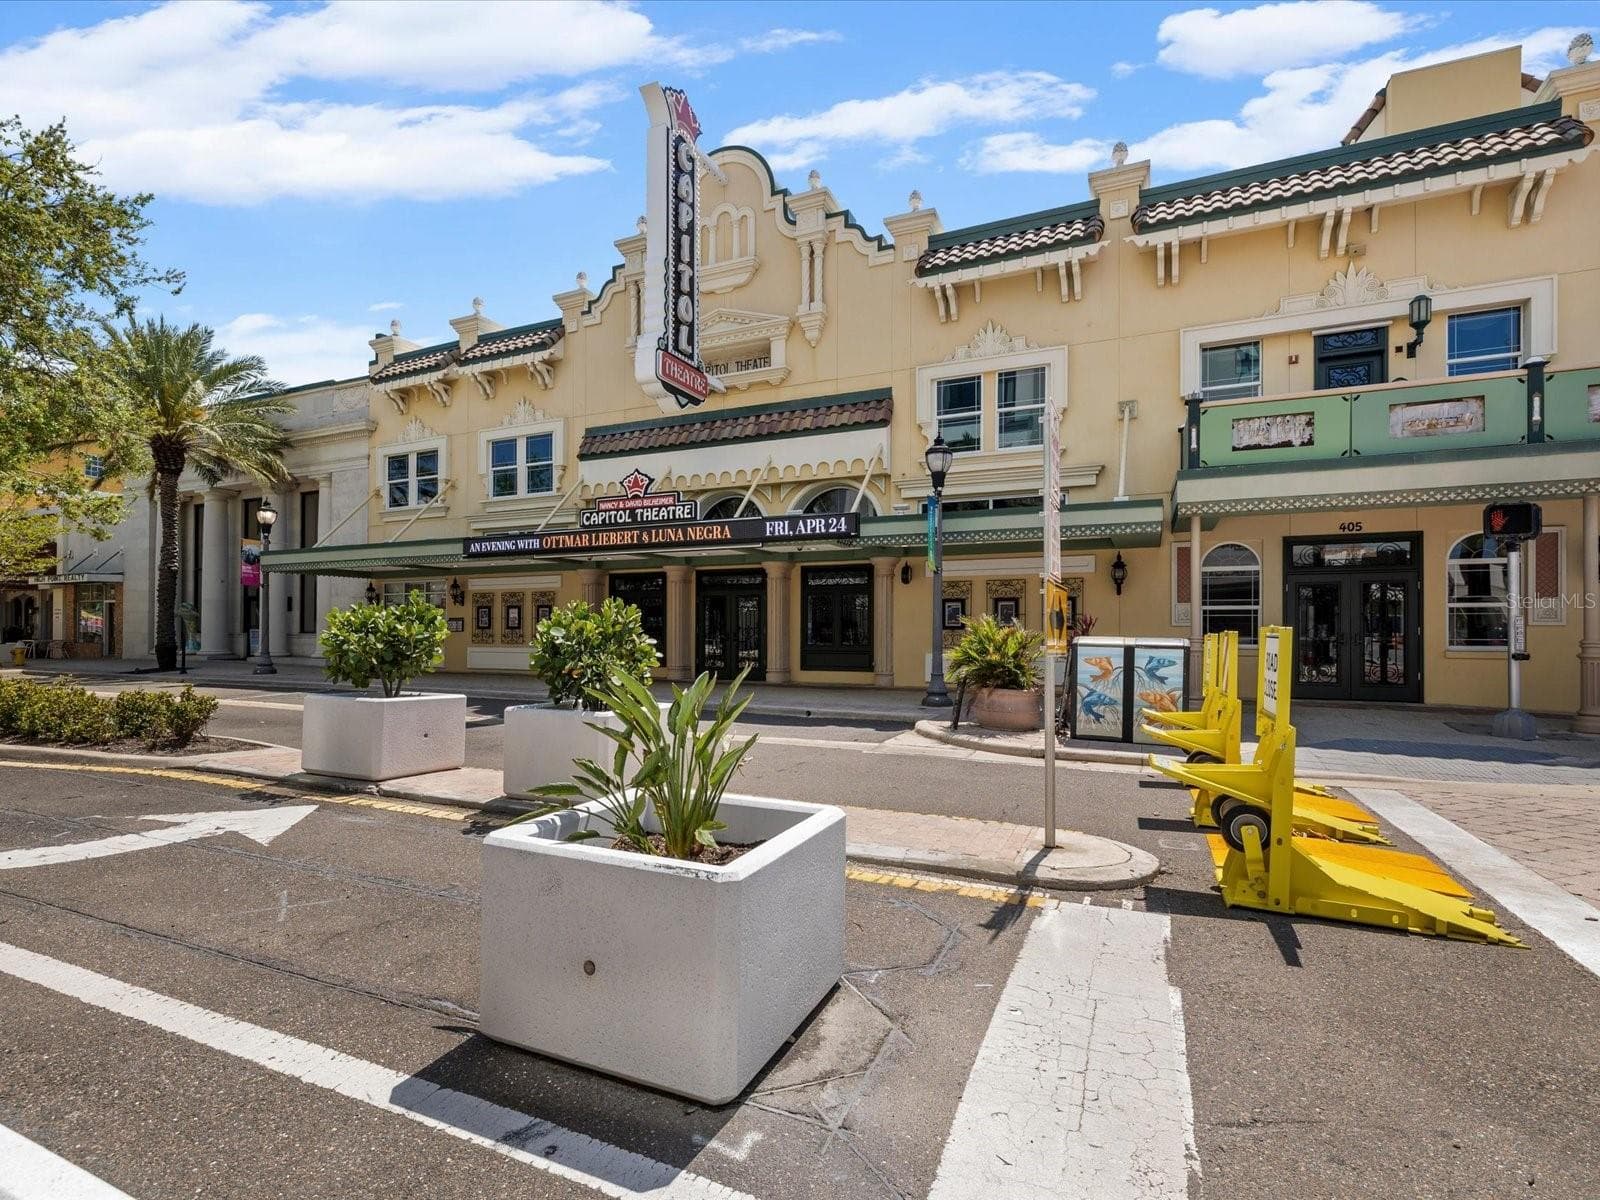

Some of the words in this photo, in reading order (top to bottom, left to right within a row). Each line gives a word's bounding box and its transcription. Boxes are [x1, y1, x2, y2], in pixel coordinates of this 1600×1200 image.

[676, 141, 694, 355] CAPITOL
[663, 357, 706, 394] THEATRE
[599, 502, 618, 510] NANCY
[625, 499, 642, 507] DAVID
[583, 511, 632, 526] CAPITOL
[635, 505, 692, 522] THEATRE
[469, 543, 481, 553] AN
[481, 540, 516, 552] EVENING
[517, 538, 540, 550] WITH
[542, 533, 589, 549] OTTMAR
[592, 530, 639, 546] LIEBERT
[642, 532, 649, 543] &
[651, 528, 684, 543] LUNA
[687, 525, 732, 541] NEGRA
[765, 520, 793, 537] FRI,
[795, 518, 825, 535] APR
[828, 516, 847, 532] 24
[1339, 521, 1363, 532] 405
[64, 573, 85, 581] REALTY
